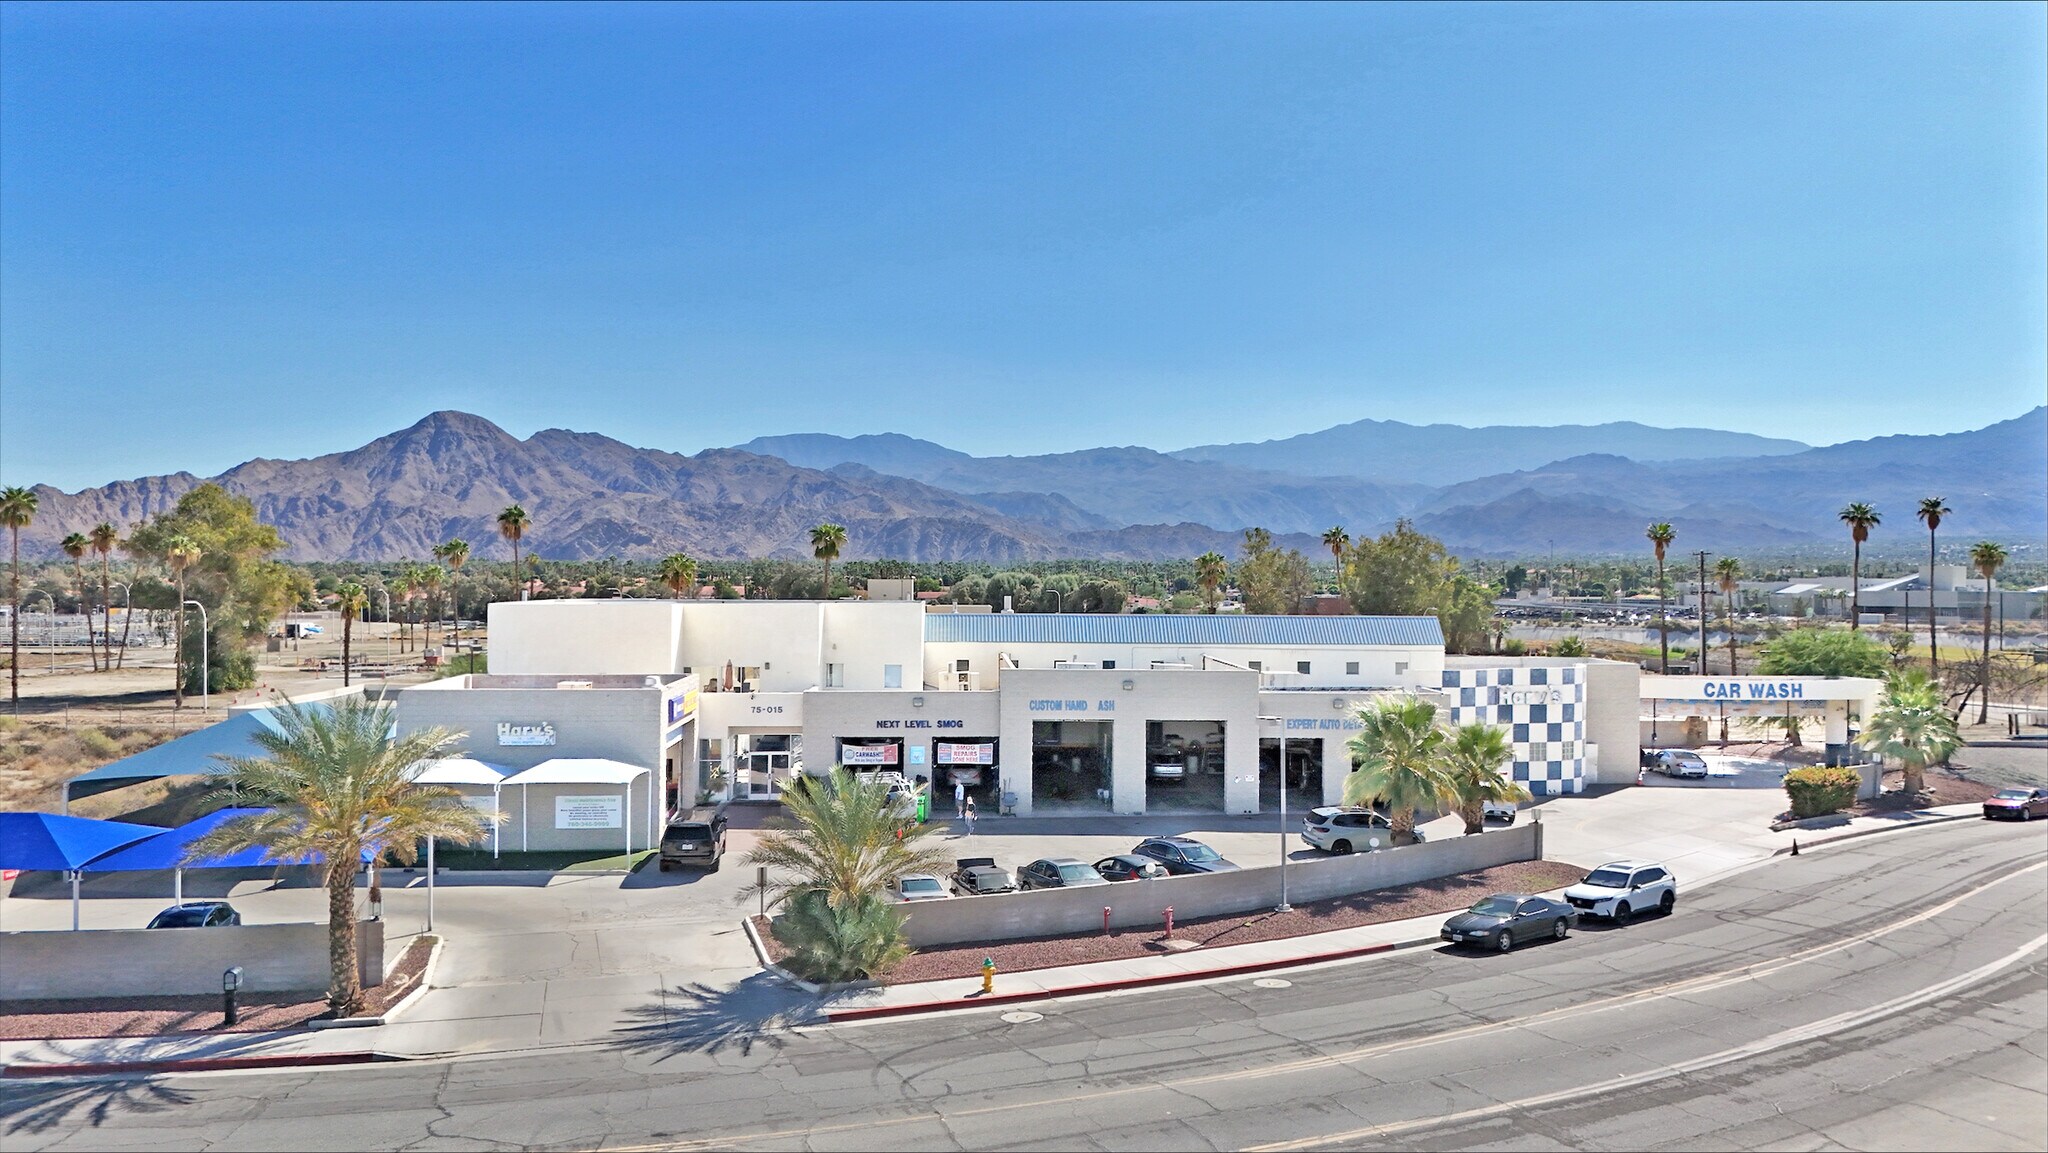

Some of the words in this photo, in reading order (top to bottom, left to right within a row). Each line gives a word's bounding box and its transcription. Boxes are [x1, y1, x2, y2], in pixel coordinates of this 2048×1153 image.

[1703, 682, 1741, 698] CAR
[1749, 683, 1803, 698] WASH
[750, 706, 783, 714] 75-015
[1029, 700, 1062, 711] CUSTOM
[1065, 700, 1088, 711] HAND
[1098, 700, 1115, 711] ASH
[876, 720, 901, 729] NEXT
[904, 720, 932, 729] LEVEL
[937, 720, 964, 729] SMOG
[1286, 719, 1318, 730] EXPERT
[1319, 719, 1341, 730] AUTO
